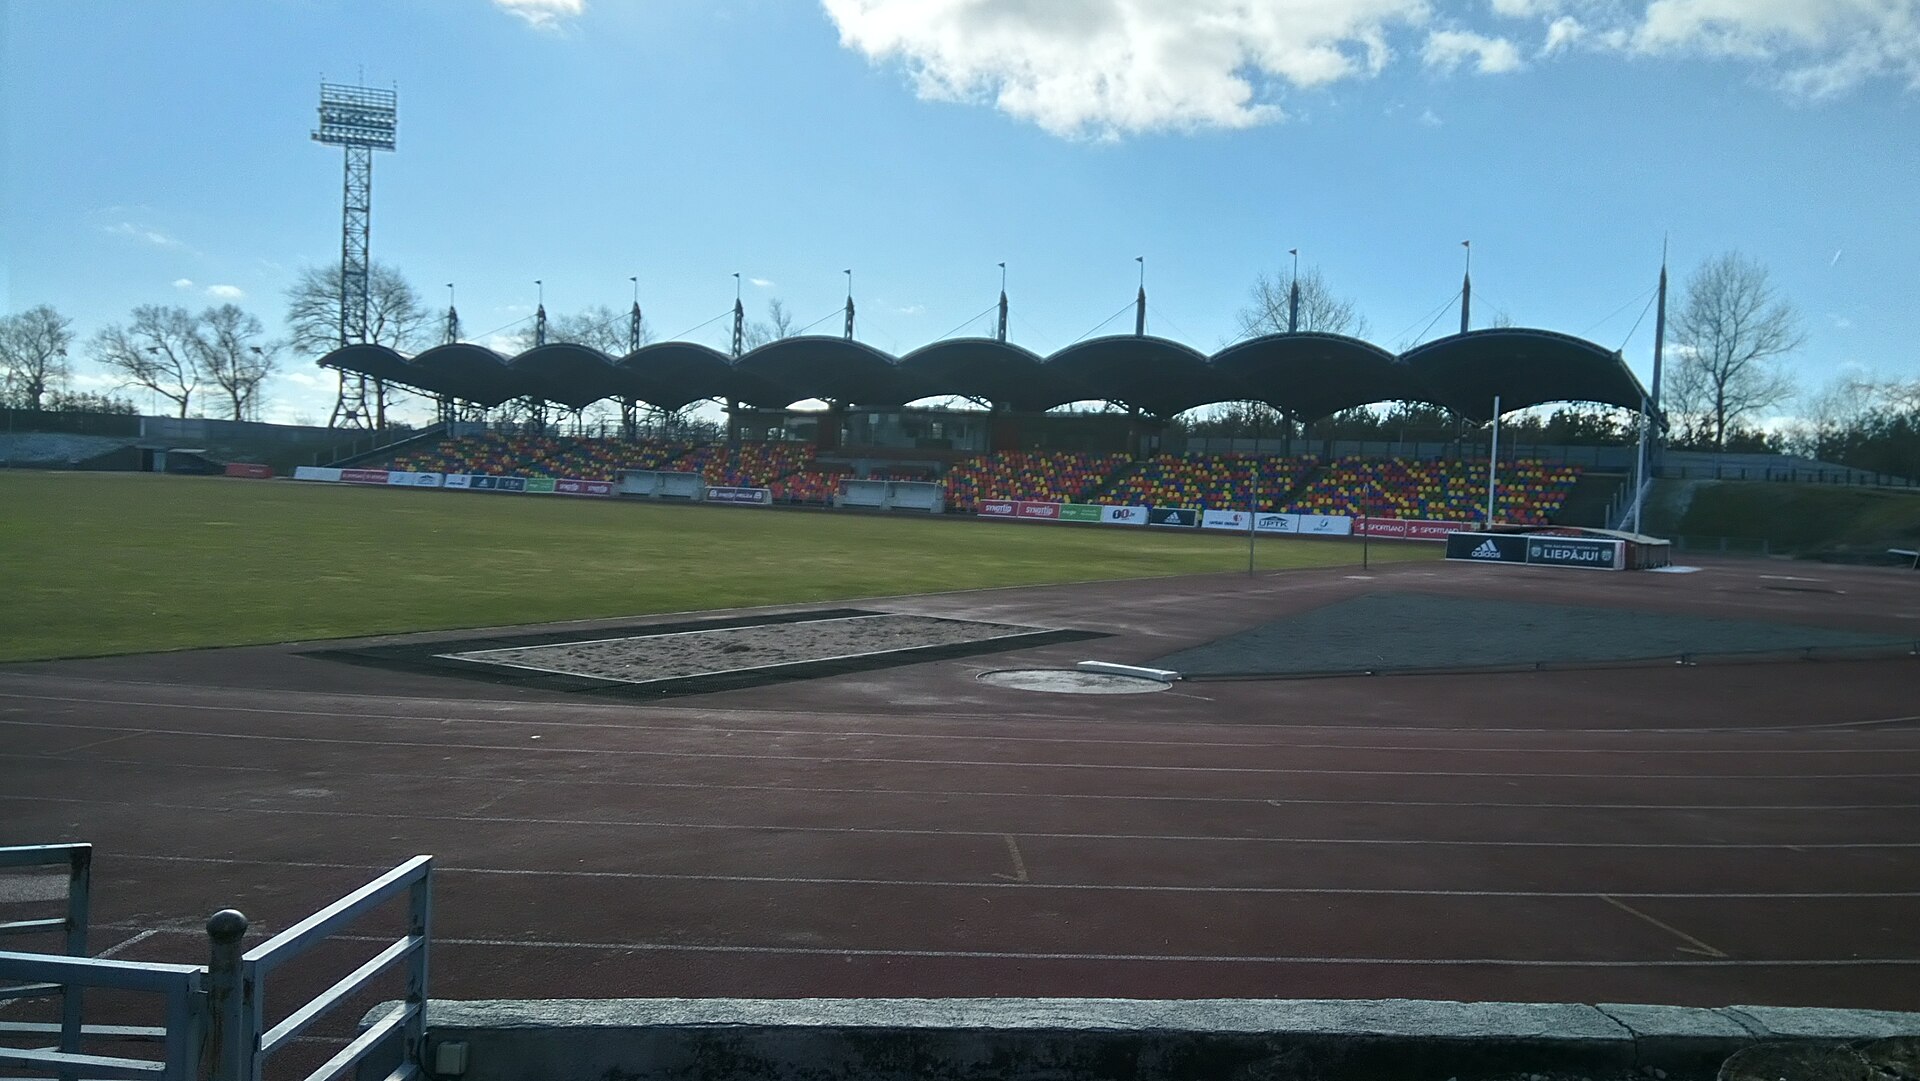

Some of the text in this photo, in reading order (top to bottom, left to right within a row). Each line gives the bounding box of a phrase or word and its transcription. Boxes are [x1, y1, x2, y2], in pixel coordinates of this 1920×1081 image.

[1259, 519, 1288, 528] UPTK
[1368, 524, 1404, 532] SPORTLAND
[1471, 549, 1501, 558] adidas
[1543, 549, 1599, 561] LIEPĀJU!
